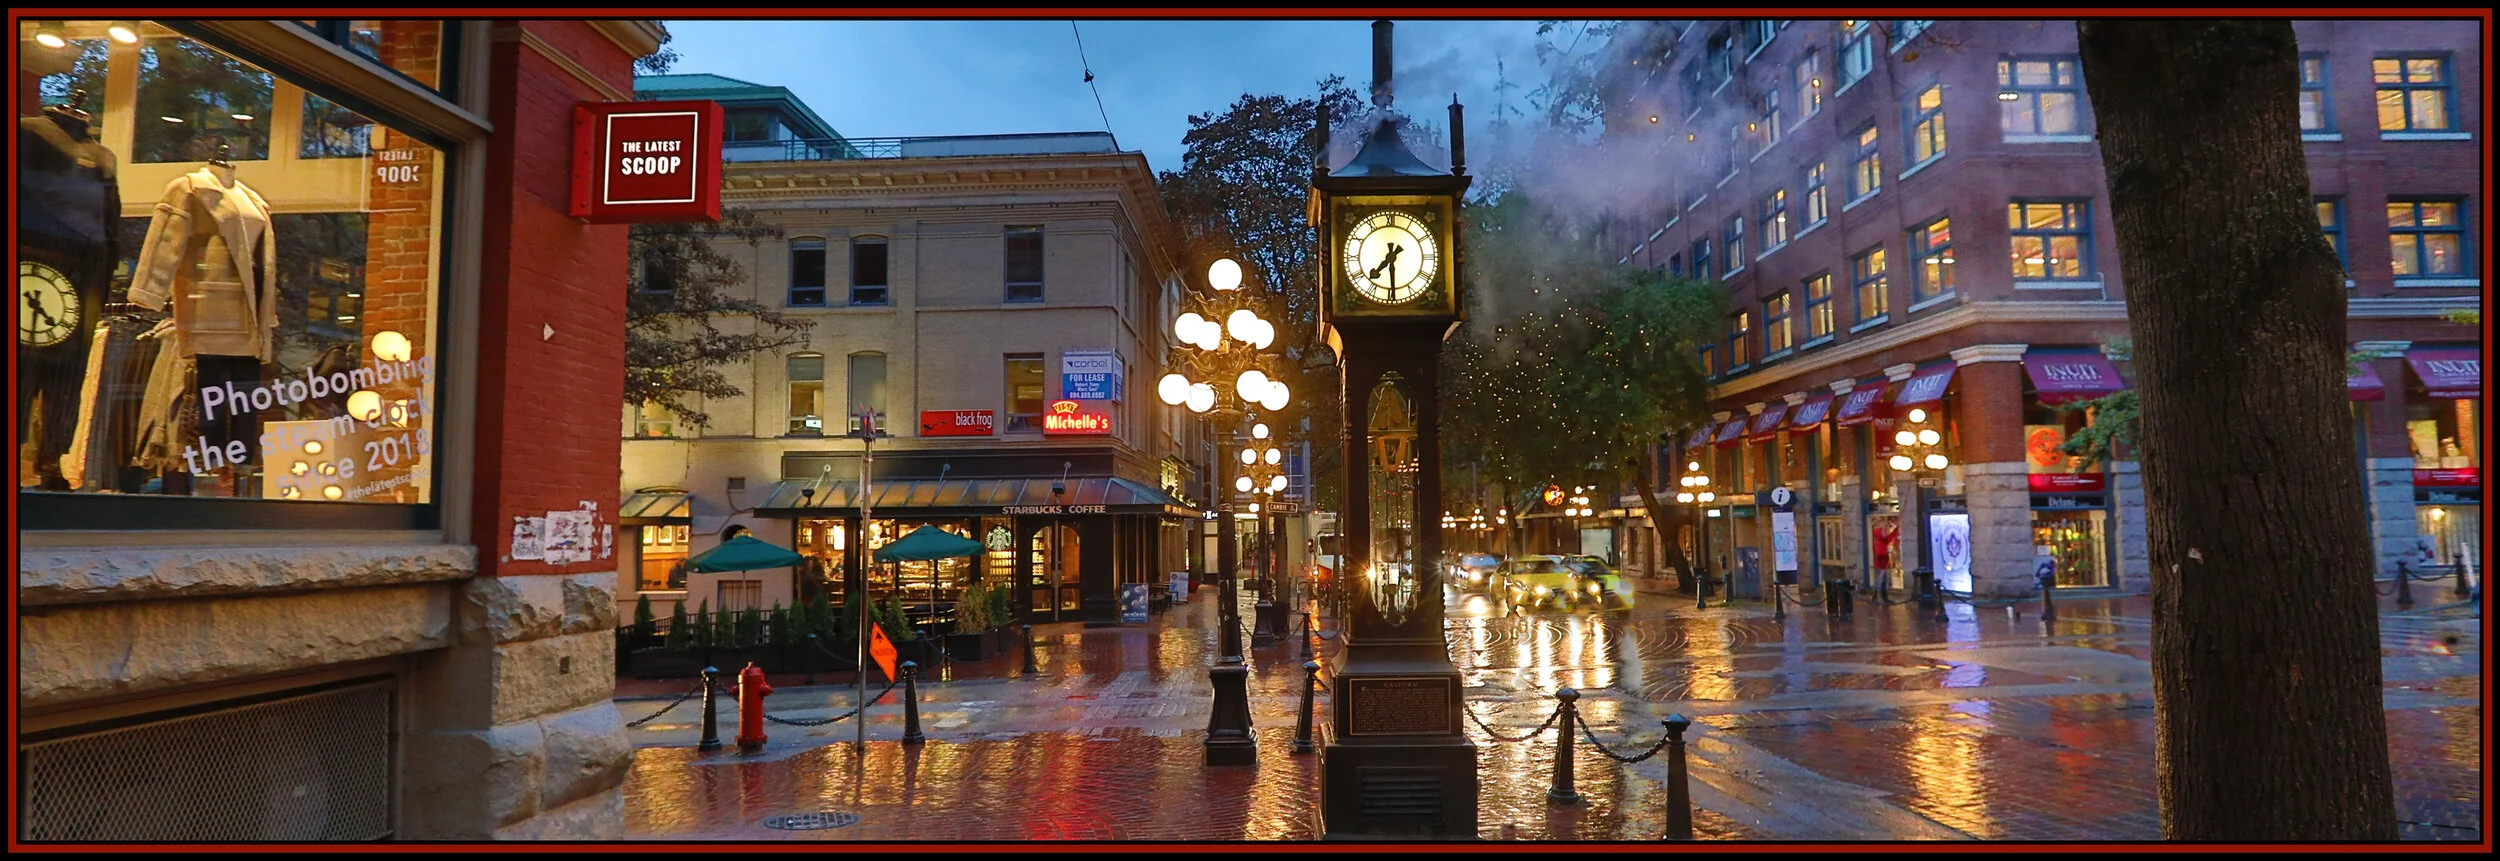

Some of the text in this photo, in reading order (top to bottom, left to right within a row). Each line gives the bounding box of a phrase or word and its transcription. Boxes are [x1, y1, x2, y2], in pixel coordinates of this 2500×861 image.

[622, 141, 681, 152] THE LATEST
[621, 156, 681, 175] SCOOP
[1073, 358, 1108, 368] corbel
[1069, 373, 1105, 382] FOR LEASE
[201, 355, 434, 421] Photobombing
[1053, 403, 1078, 412] VISIT
[955, 411, 992, 429] black frog
[1045, 414, 1108, 430] Michelle's
[182, 387, 433, 475] the steam clock
[276, 428, 431, 491] since 2018
[1002, 505, 1106, 514] STARBUCKS COFFEE
[1269, 503, 1287, 511] CAMBIE
